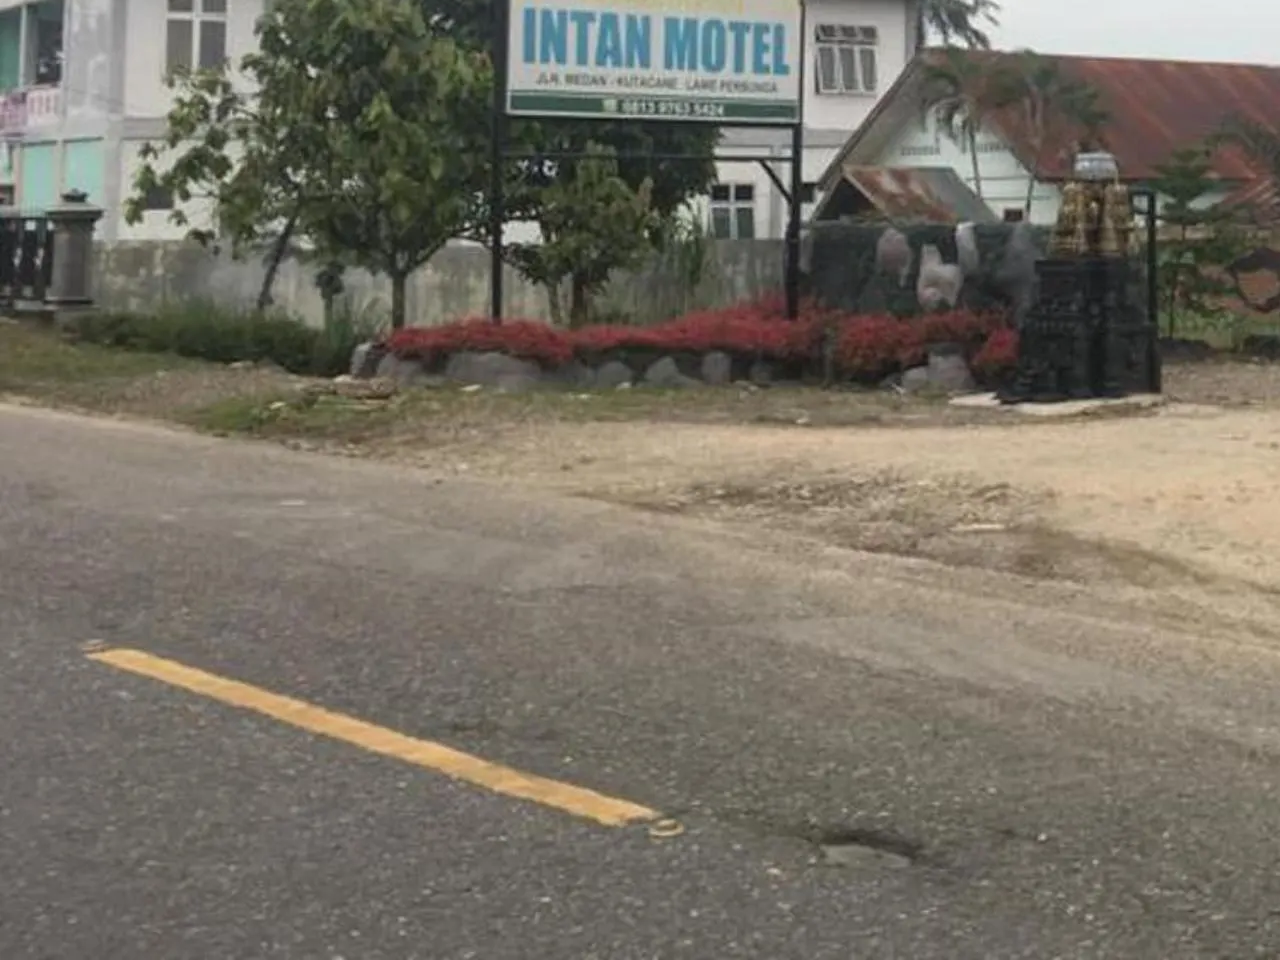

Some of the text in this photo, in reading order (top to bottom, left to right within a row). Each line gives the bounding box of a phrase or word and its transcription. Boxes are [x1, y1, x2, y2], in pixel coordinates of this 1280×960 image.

[523, 7, 790, 76] INTAN MOTEL
[565, 74, 607, 88] MEDAN
